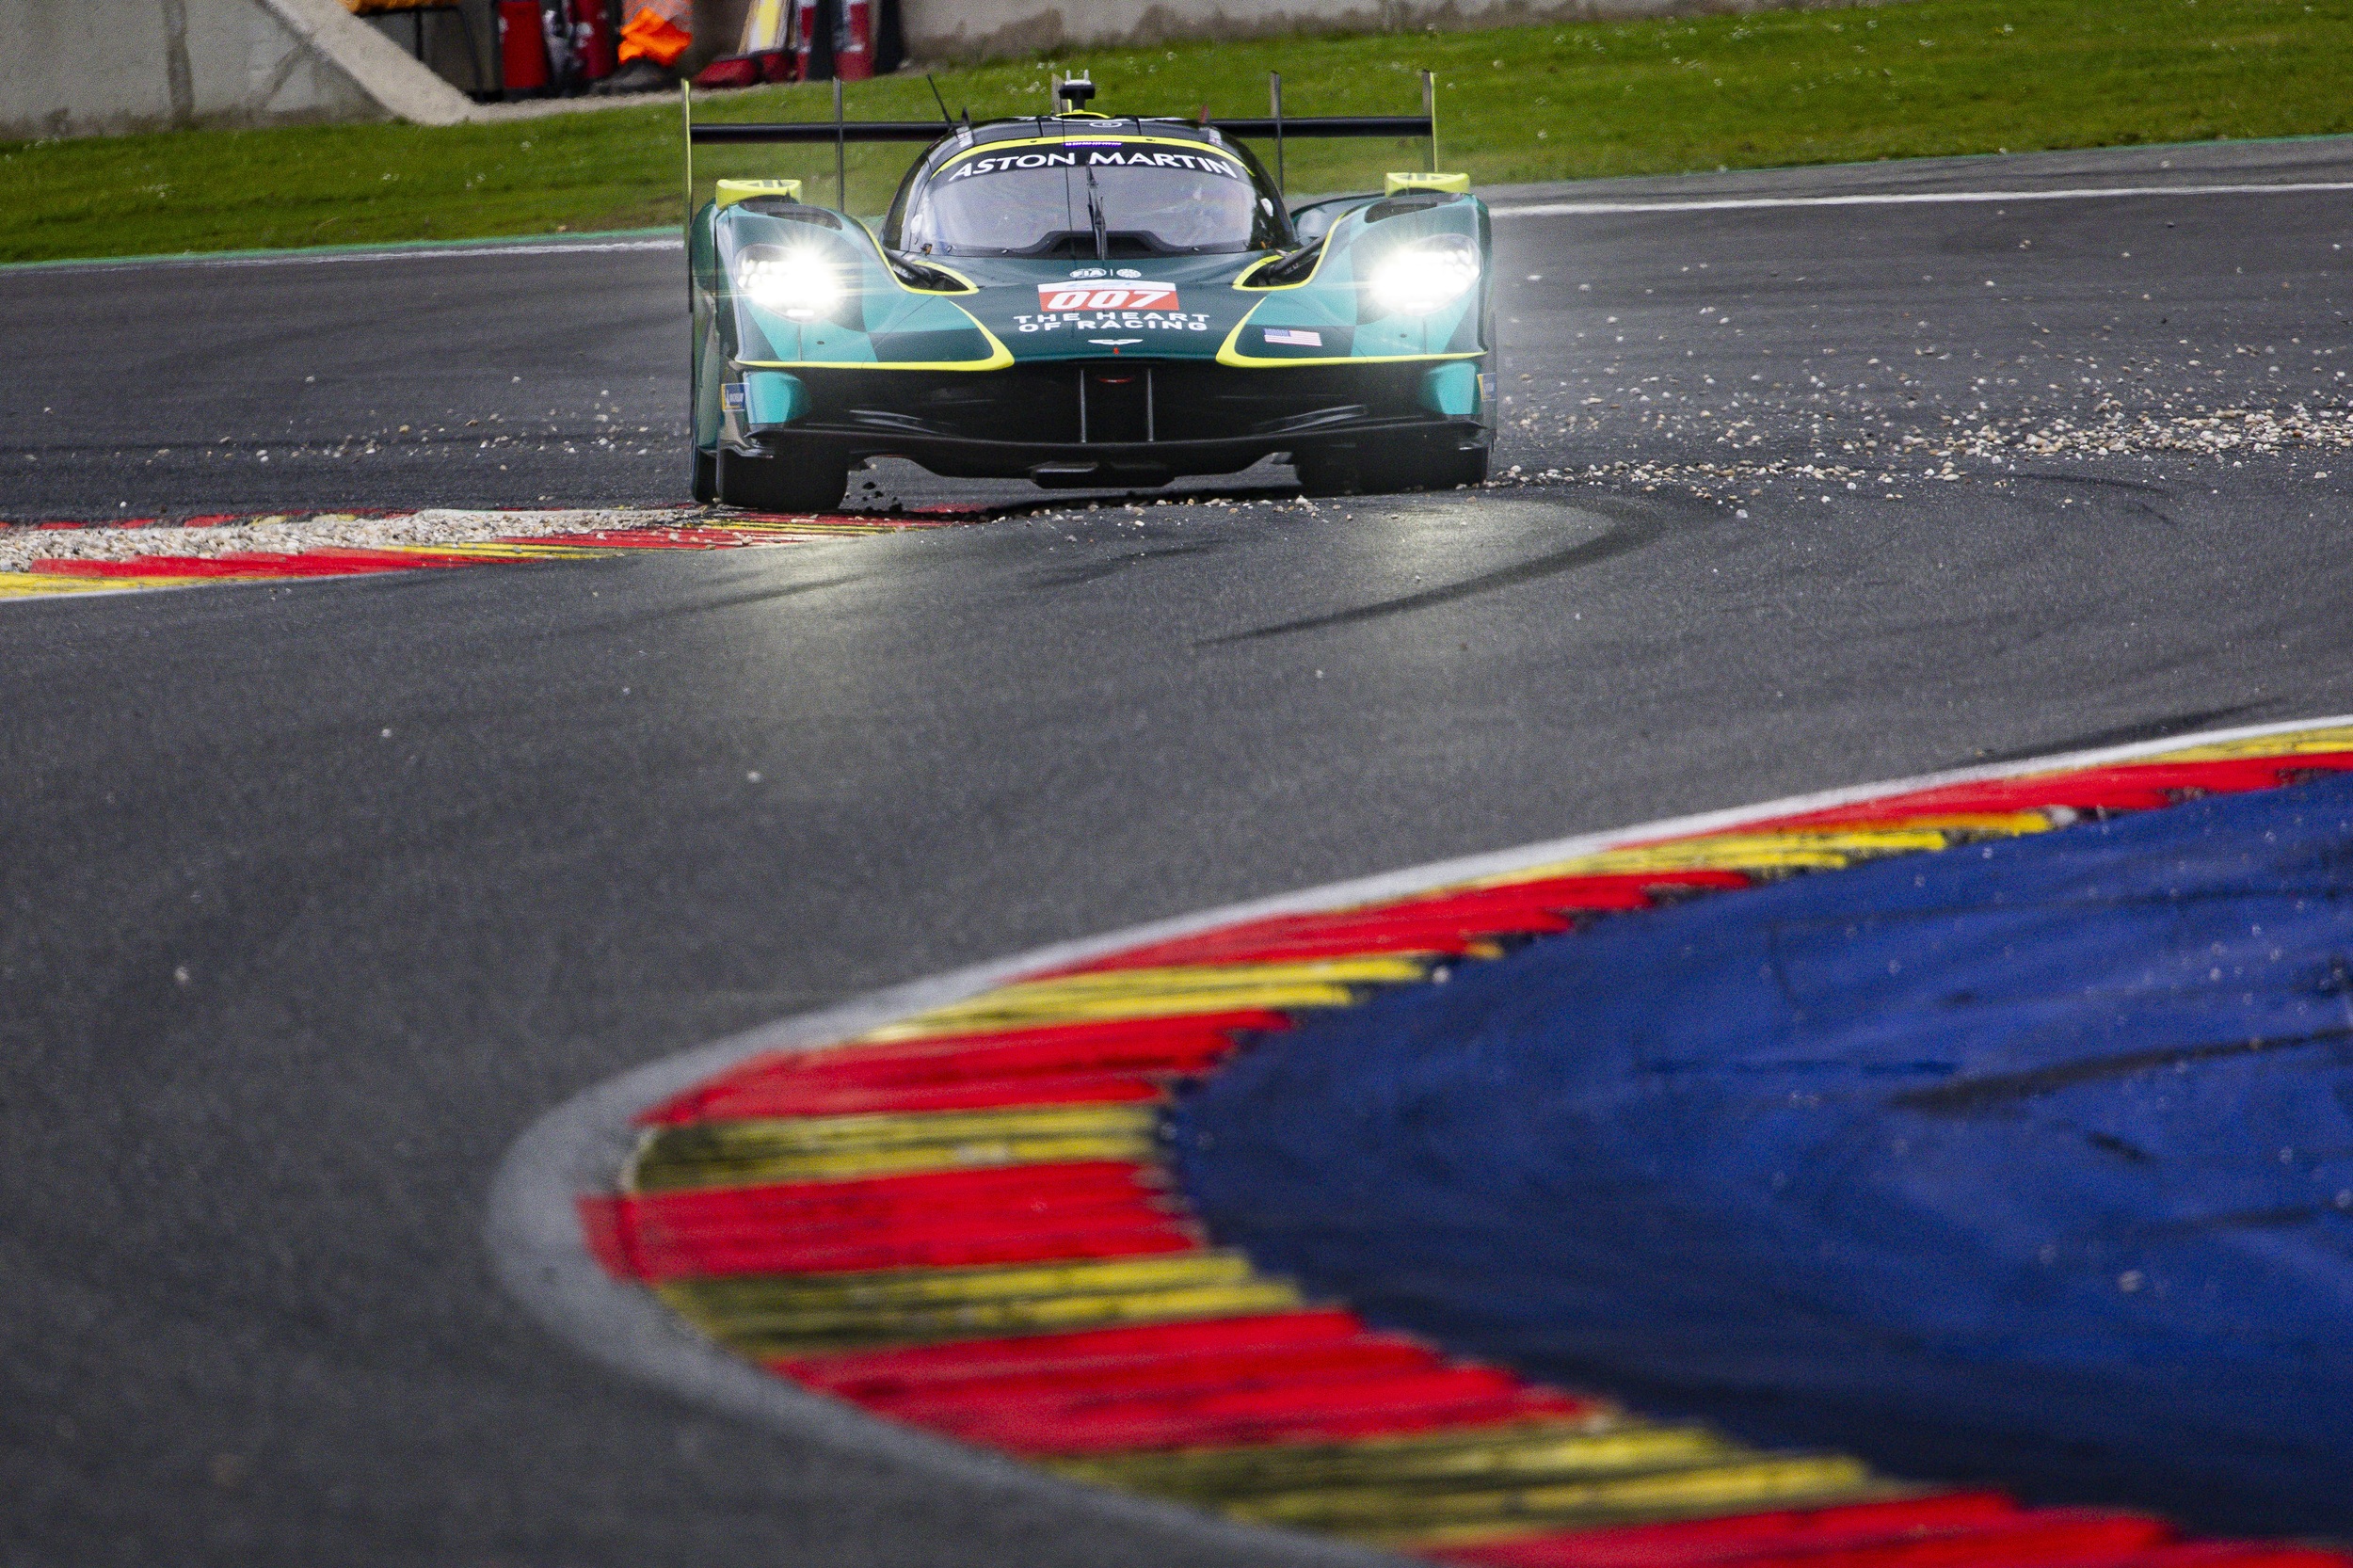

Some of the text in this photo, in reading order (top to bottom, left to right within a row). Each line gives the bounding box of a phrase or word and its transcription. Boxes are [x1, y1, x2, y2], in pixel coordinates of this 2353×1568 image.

[949, 152, 1238, 182] ASTON MARTIN
[1047, 290, 1170, 310] 007
[1014, 312, 1210, 324] THE HEART
[1018, 320, 1208, 333] OF RACING
